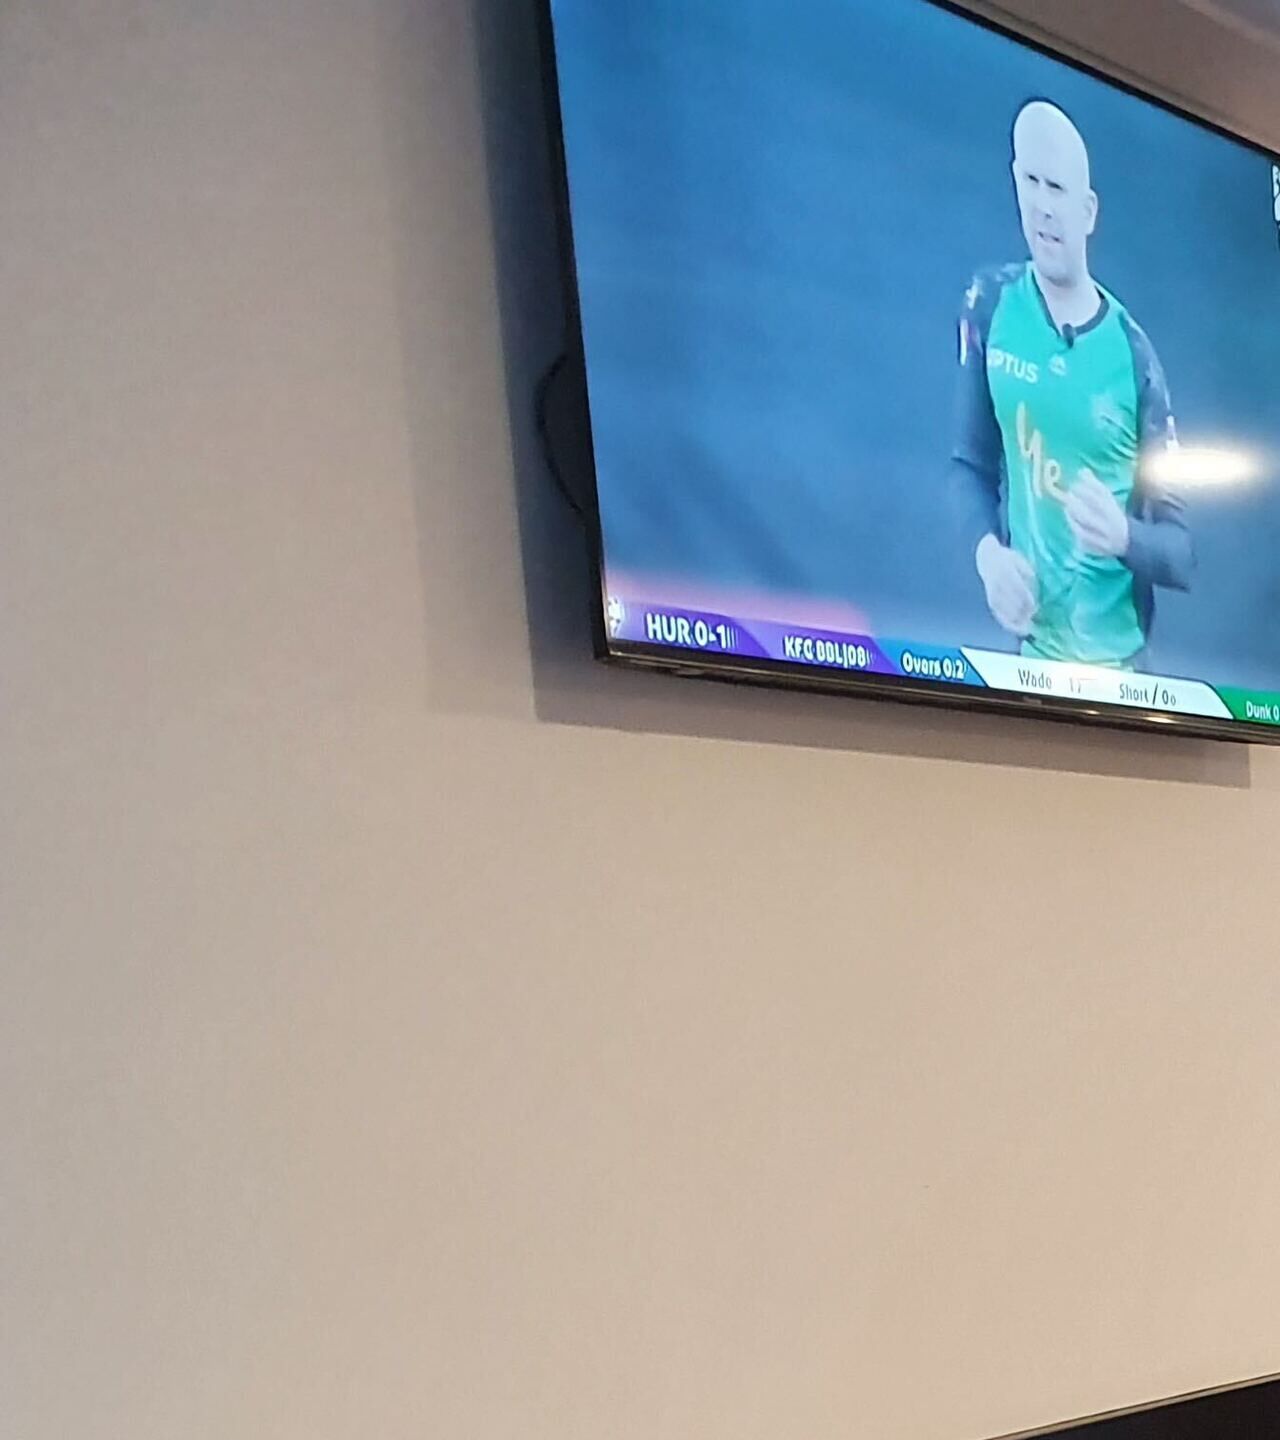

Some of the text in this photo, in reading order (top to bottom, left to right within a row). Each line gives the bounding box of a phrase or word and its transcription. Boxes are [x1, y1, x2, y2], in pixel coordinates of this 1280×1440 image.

[645, 612, 692, 645] HUR
[783, 635, 815, 661] KFC
[902, 651, 942, 678] Overs
[1245, 700, 1272, 721] Dunk
